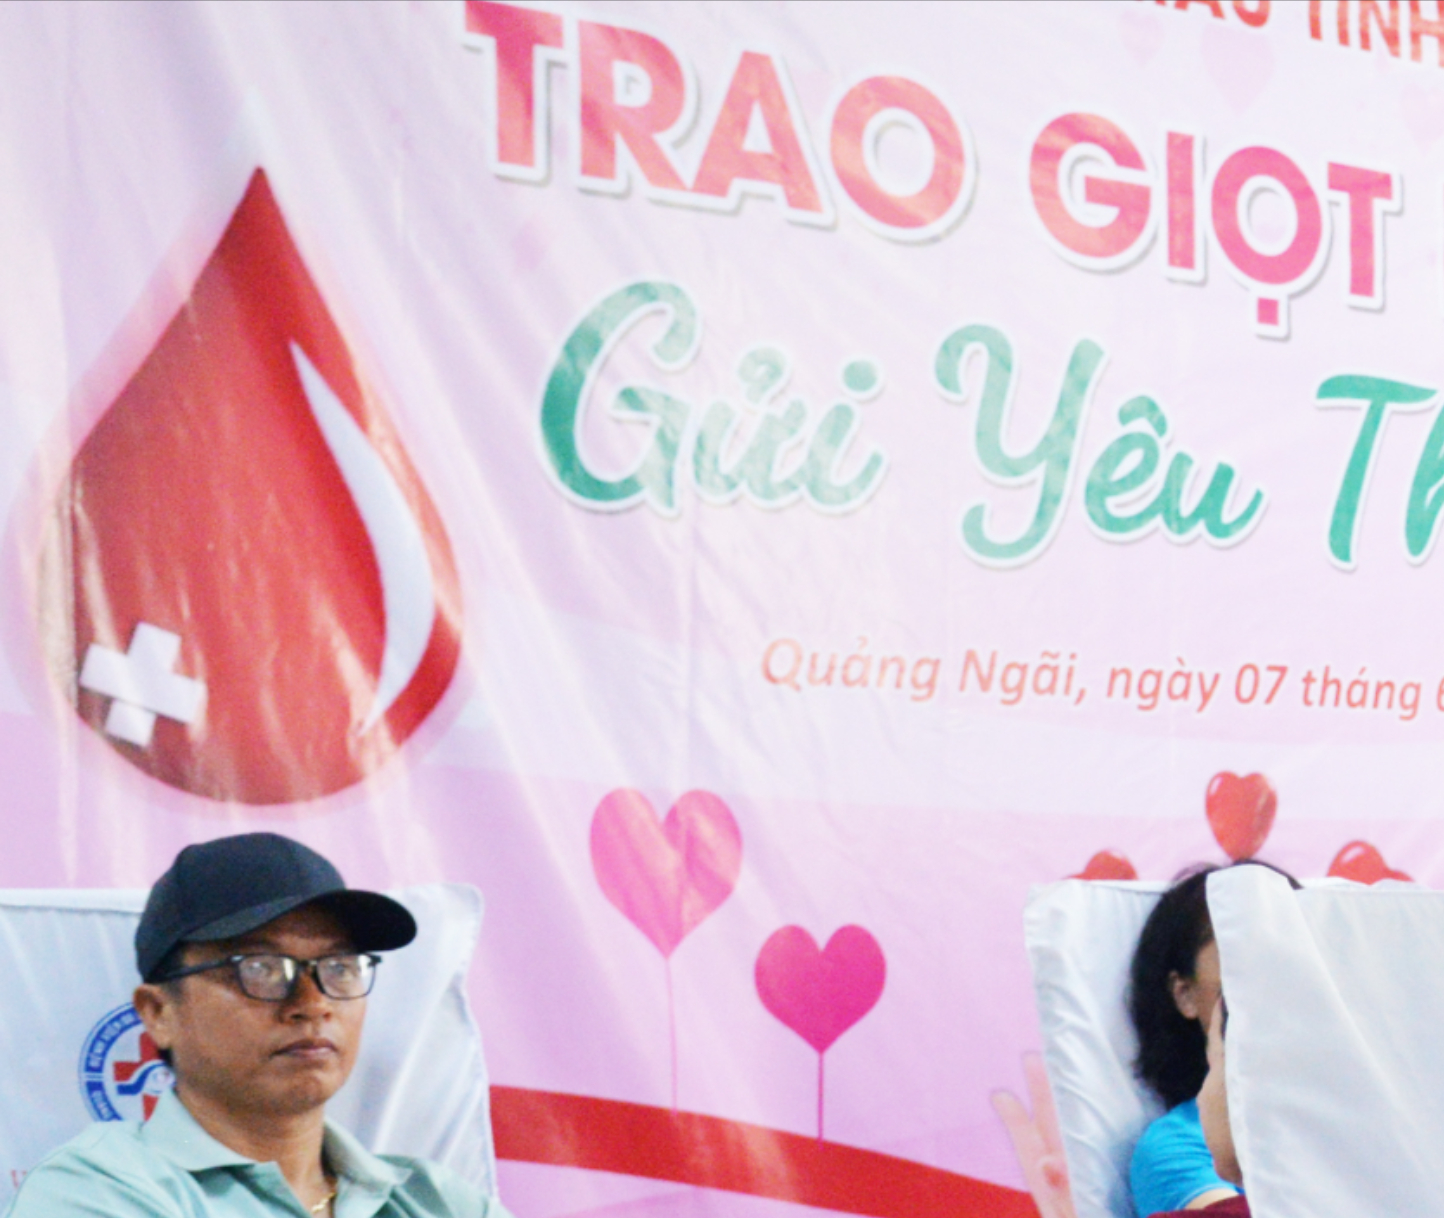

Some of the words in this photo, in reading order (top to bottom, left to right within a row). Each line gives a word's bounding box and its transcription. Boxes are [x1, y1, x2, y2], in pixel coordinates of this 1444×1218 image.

[464, 0, 966, 230] TRAO
[1029, 112, 1393, 326] GIỌT
[540, 281, 884, 510] Gửi
[934, 324, 1264, 560] Yêu
[760, 636, 941, 702] Quảng
[958, 647, 1087, 706] Ngãi,
[1106, 653, 1221, 713] ngày
[1235, 663, 1288, 706] 07
[1301, 664, 1421, 721] tháng
